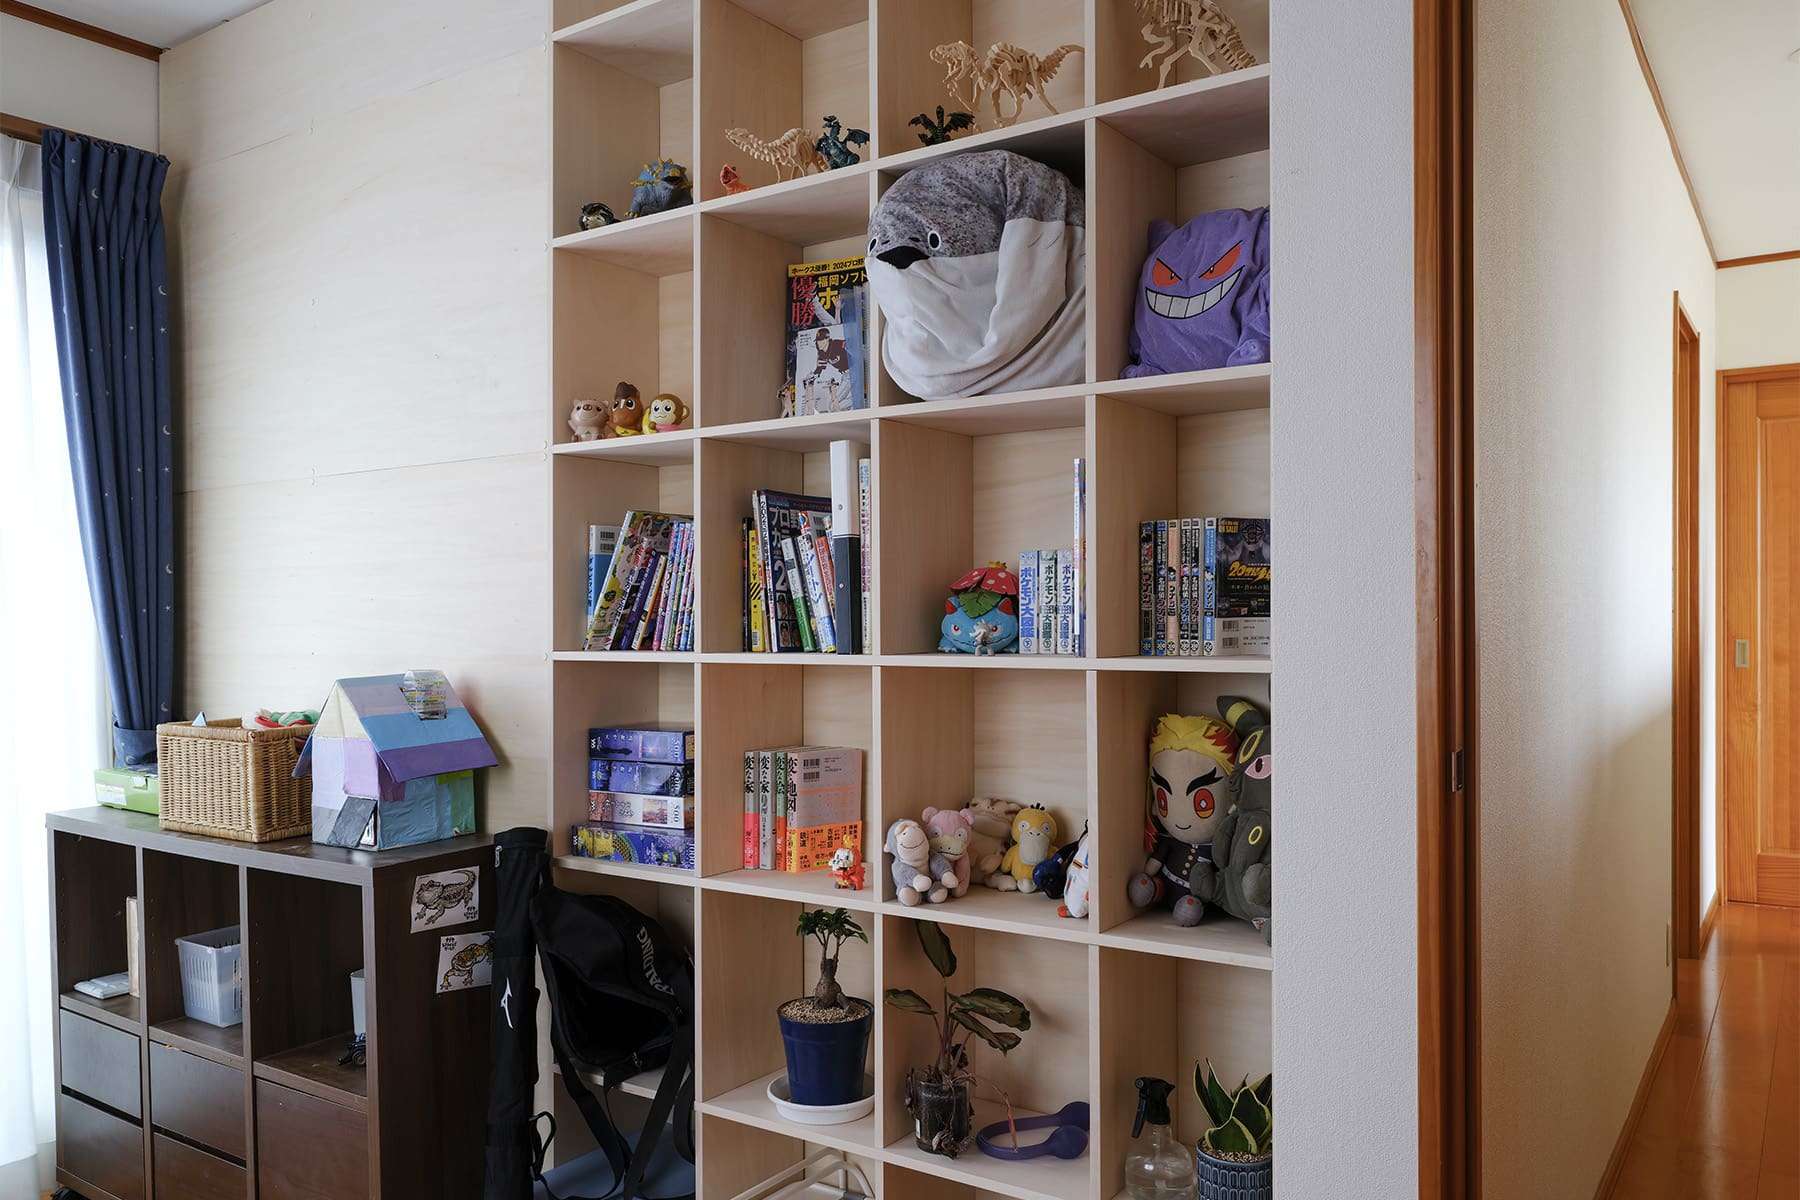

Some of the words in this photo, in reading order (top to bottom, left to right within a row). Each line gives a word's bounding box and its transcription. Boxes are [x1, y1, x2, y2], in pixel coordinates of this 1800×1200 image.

[744, 755, 755, 794] 変な家
[637, 926, 676, 996] PALDING
